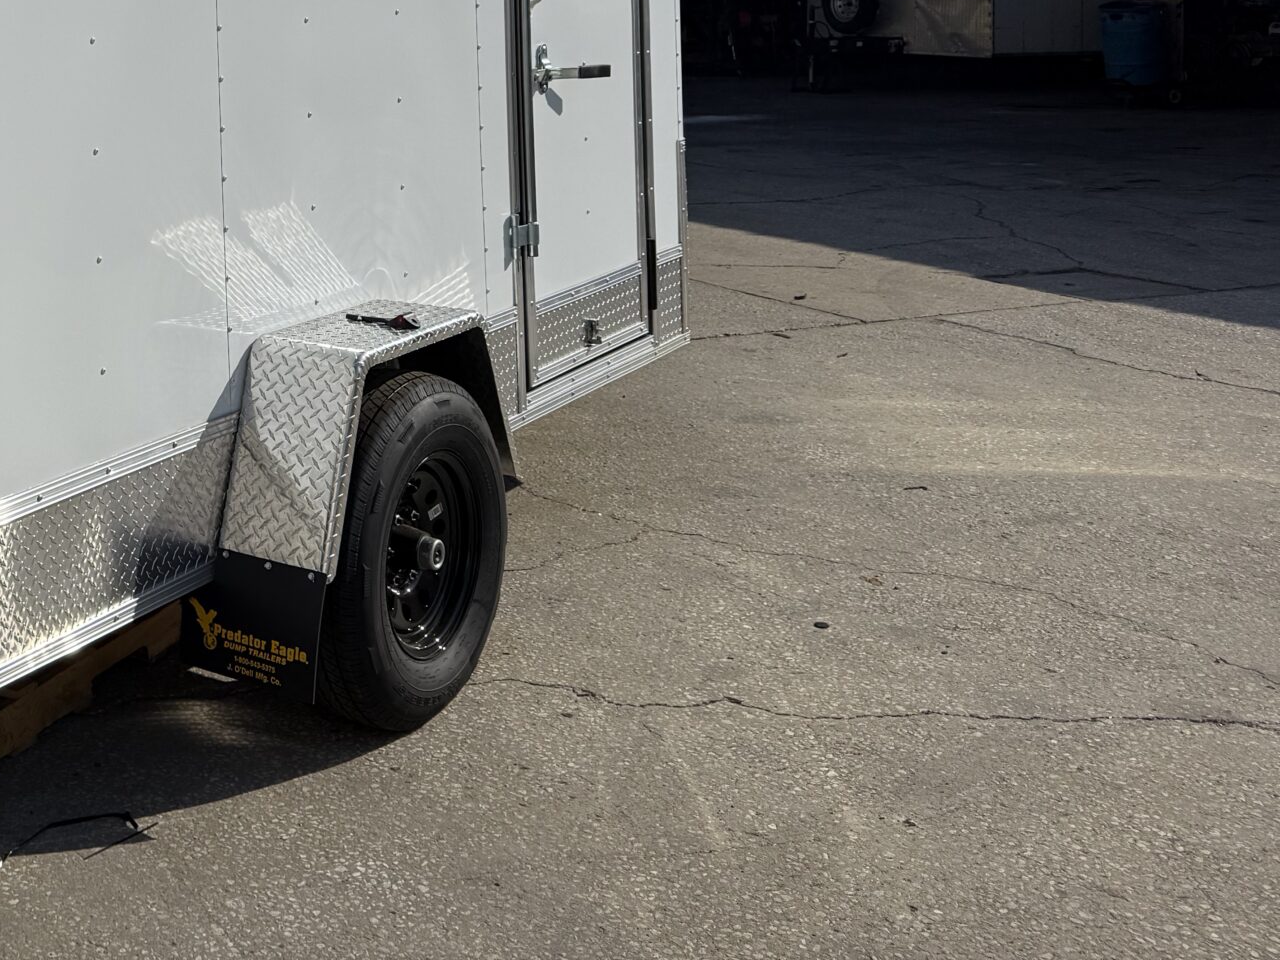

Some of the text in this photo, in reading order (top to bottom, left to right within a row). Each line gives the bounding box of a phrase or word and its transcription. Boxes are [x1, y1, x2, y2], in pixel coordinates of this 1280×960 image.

[213, 623, 267, 649] Predator
[224, 642, 287, 665] DUMP TRAILERS
[234, 665, 254, 678] O'Dell
[270, 676, 282, 687] Co.
